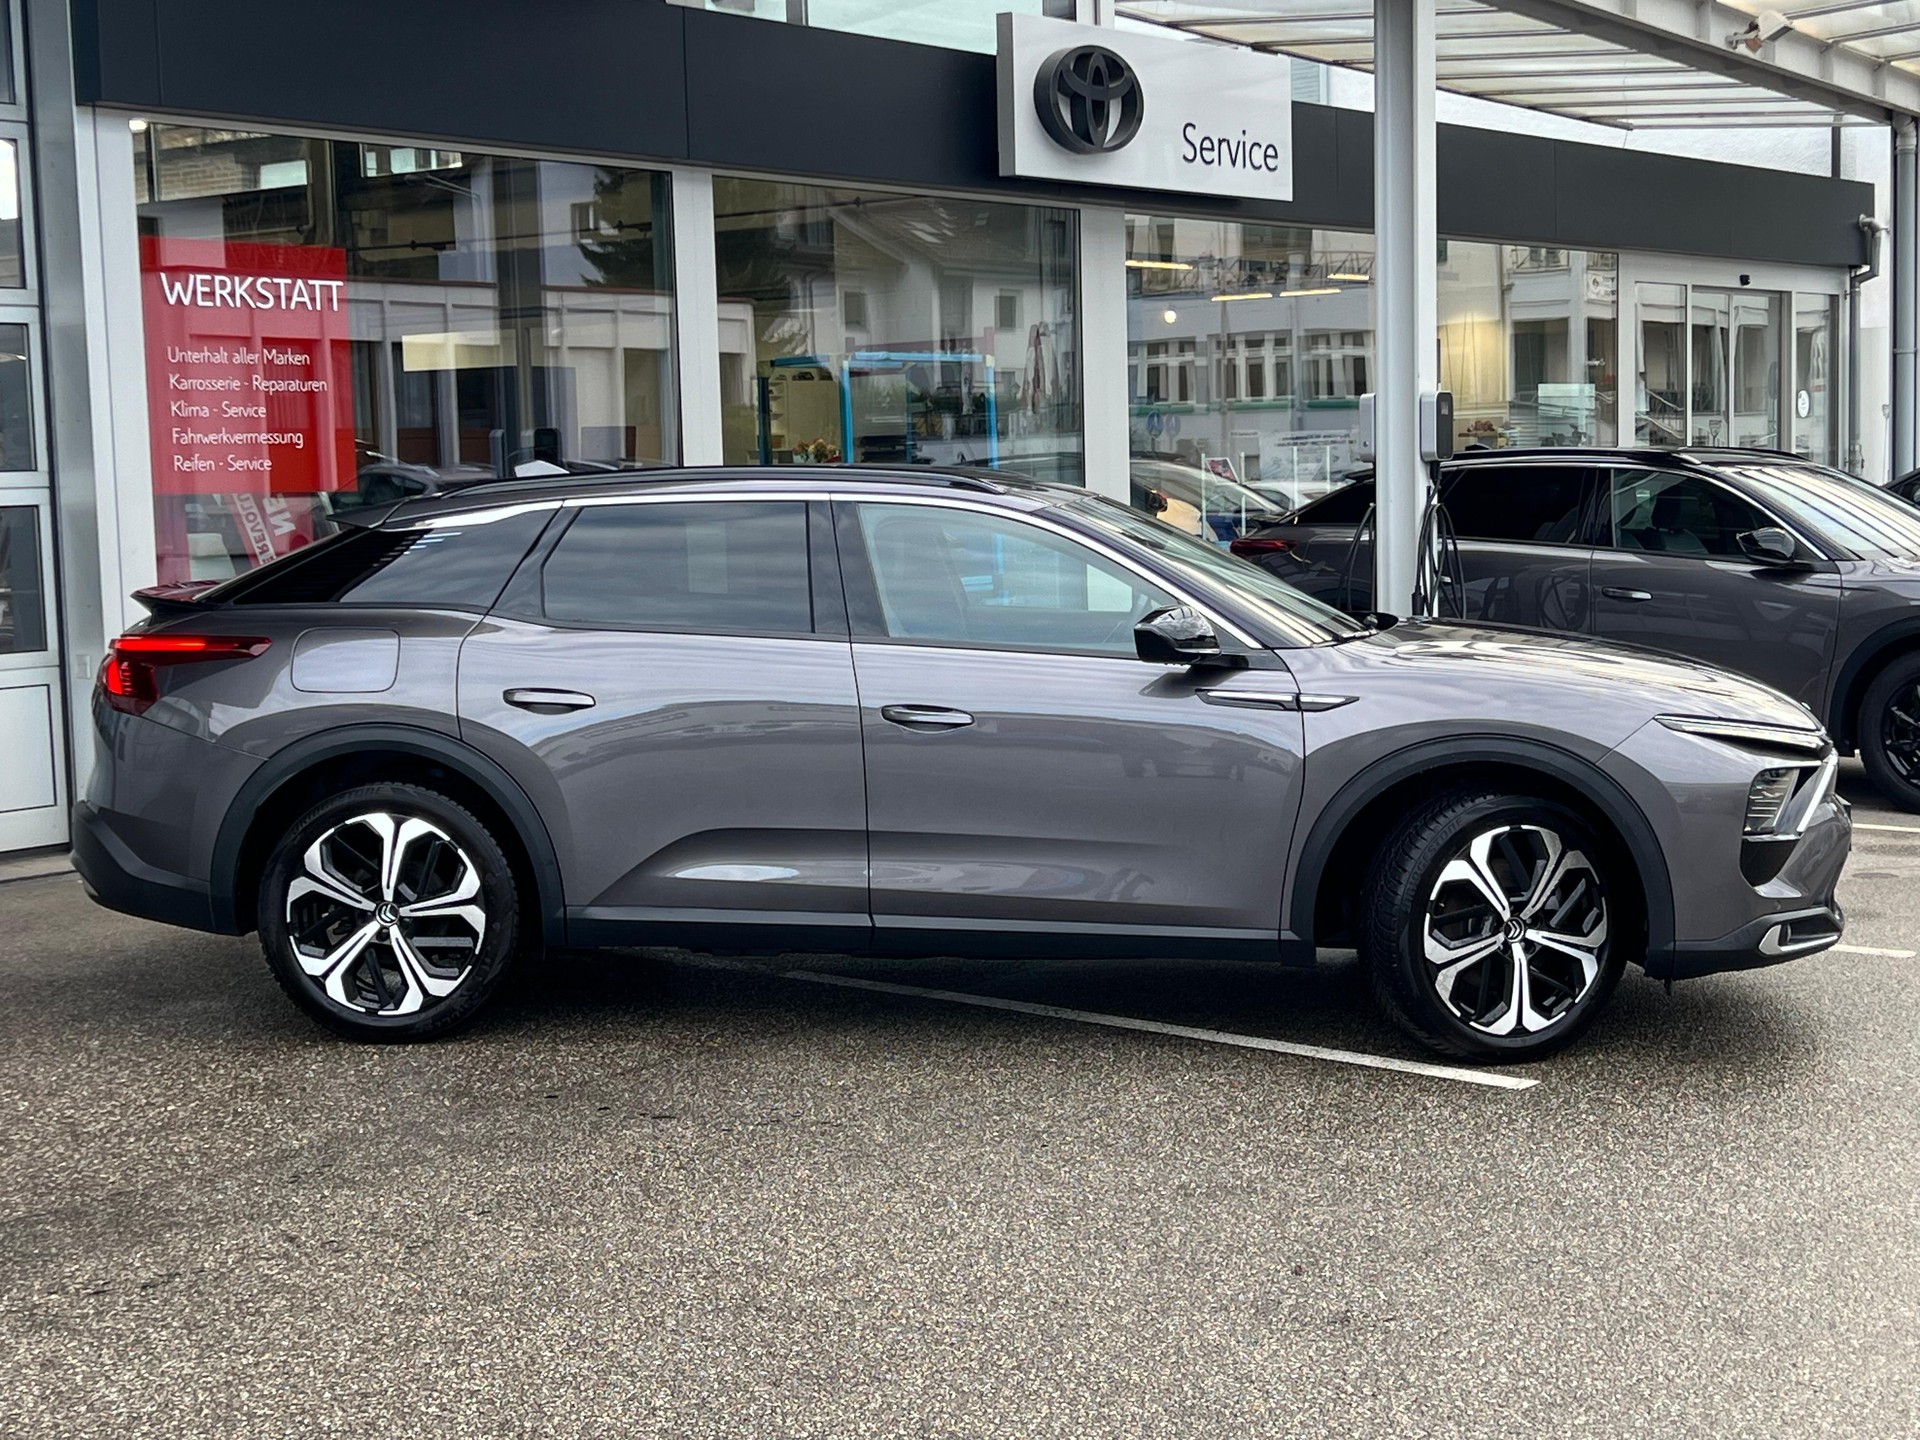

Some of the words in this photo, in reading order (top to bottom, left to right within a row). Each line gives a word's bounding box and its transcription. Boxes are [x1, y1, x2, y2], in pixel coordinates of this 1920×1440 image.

[1182, 122, 1278, 172] Service
[160, 272, 344, 311] WERKSTATT
[167, 346, 228, 364] Unterhalt
[232, 347, 260, 365] aller
[263, 348, 311, 366] Marken
[169, 373, 241, 391] Karrosserie
[252, 374, 328, 396] Reparaturen
[171, 400, 210, 418] Klima
[221, 401, 267, 418] Service
[172, 427, 304, 448] Fahrwerkvermessung
[174, 454, 216, 472] Reifen
[227, 455, 273, 472] Service
